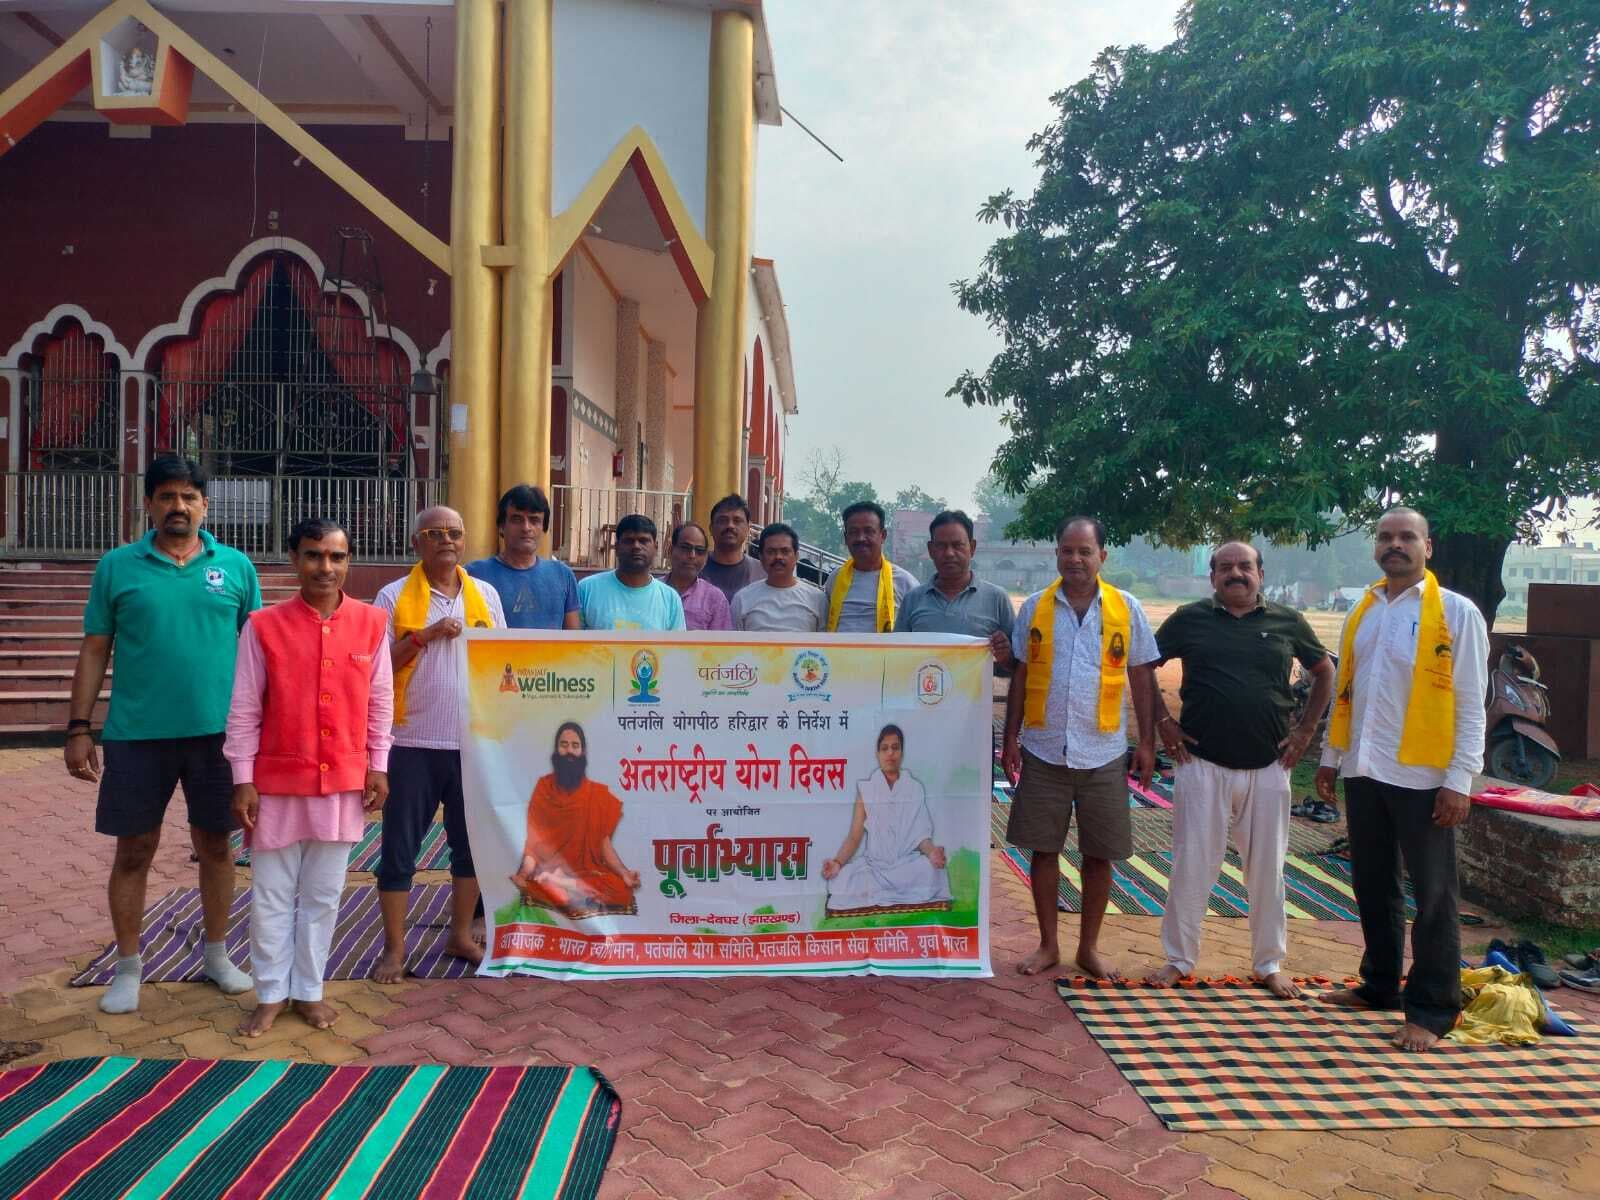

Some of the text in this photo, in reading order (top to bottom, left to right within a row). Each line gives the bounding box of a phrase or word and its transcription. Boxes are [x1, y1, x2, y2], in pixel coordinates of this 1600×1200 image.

[517, 671, 595, 692] wellness
[697, 663, 753, 681] पतंजलि
[617, 710, 849, 731] पतंजलि योगपीठ हरिद्वार के निर्देश में
[619, 744, 848, 803] अंतर्राष्ट्रीय योग दिवस
[706, 805, 760, 816] पर आयोजित
[652, 823, 812, 899] पूर्वाभ्यास
[559, 936, 588, 956] भारत
[644, 937, 687, 959] पतंजलि
[691, 937, 714, 958] योग
[805, 934, 842, 956] किसान
[846, 931, 869, 953] सेवा
[917, 934, 939, 958] युवा
[942, 935, 968, 953] भारत
